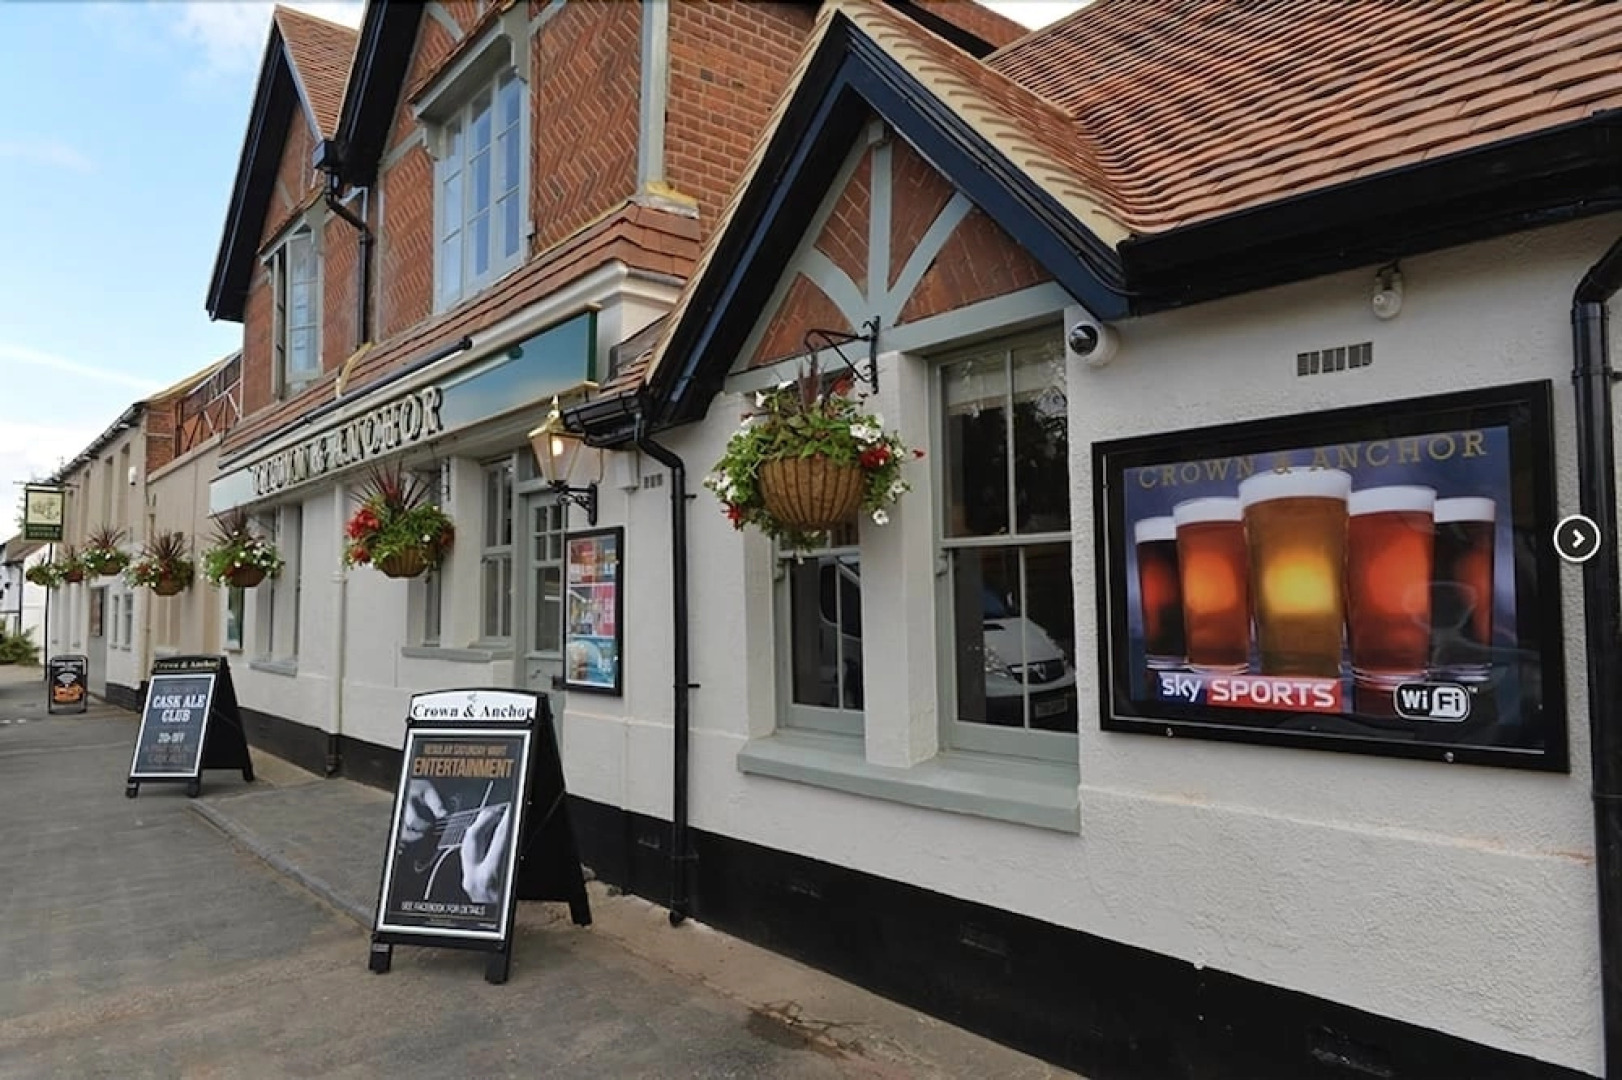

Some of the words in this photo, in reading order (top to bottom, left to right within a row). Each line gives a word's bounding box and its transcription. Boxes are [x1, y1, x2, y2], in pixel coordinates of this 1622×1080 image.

[335, 386, 444, 468] ANCHOR
[1138, 454, 1253, 489] CROWN
[1272, 452, 1293, 475] &
[1310, 430, 1487, 473] ANCHOR
[152, 695, 183, 708] CASK
[182, 694, 207, 708] ALE
[1162, 674, 1201, 703] sky
[1211, 680, 1336, 708] SPORTS
[161, 709, 191, 722] CLUB
[413, 704, 459, 718] Crown
[463, 704, 475, 718] &
[480, 704, 533, 718] Anchor
[412, 757, 515, 777] ENTERTAINMENT
